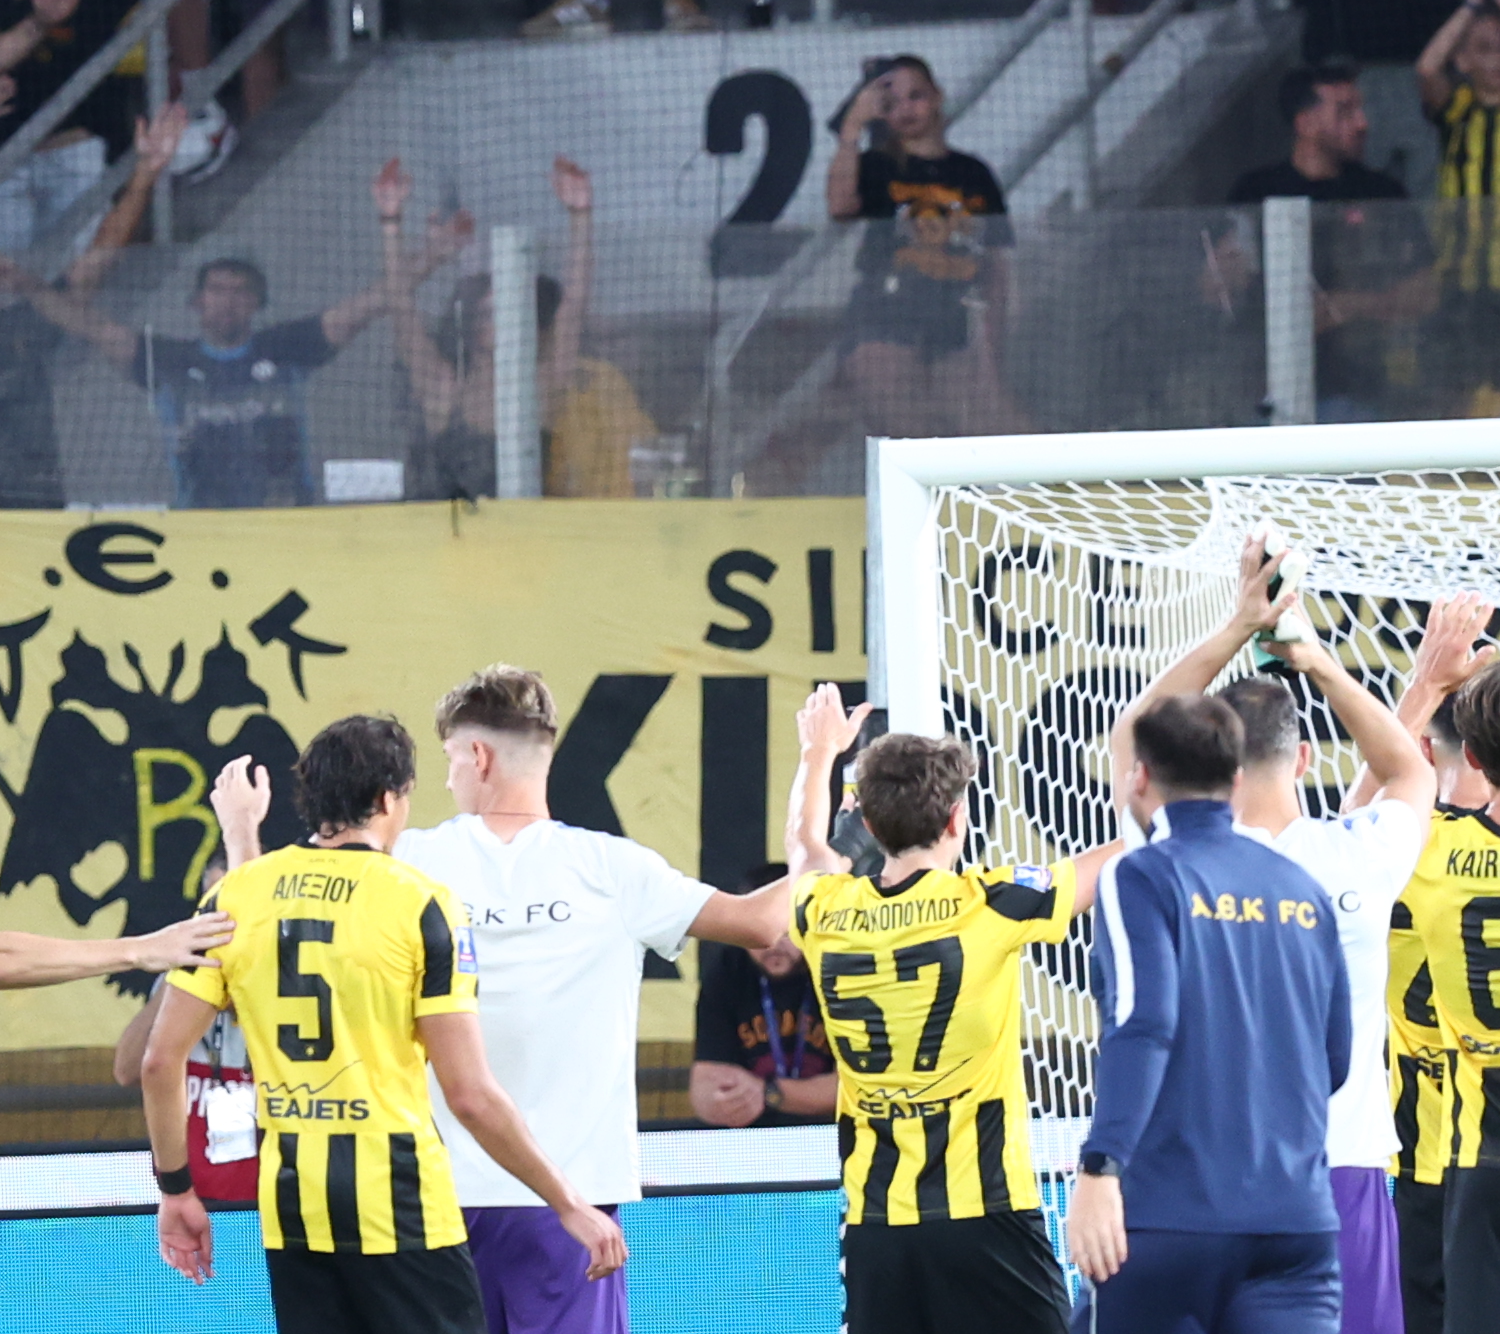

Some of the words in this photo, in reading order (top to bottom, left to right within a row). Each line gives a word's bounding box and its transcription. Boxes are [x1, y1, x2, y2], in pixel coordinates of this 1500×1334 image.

[705, 69, 814, 279] 2
[273, 873, 359, 904] ΑΛΕΞΙΟΥ
[526, 900, 572, 924] FC
[1278, 899, 1318, 930] FC
[277, 917, 335, 1062] 5
[819, 934, 965, 1075] 57
[264, 1098, 370, 1121] EAJETS
